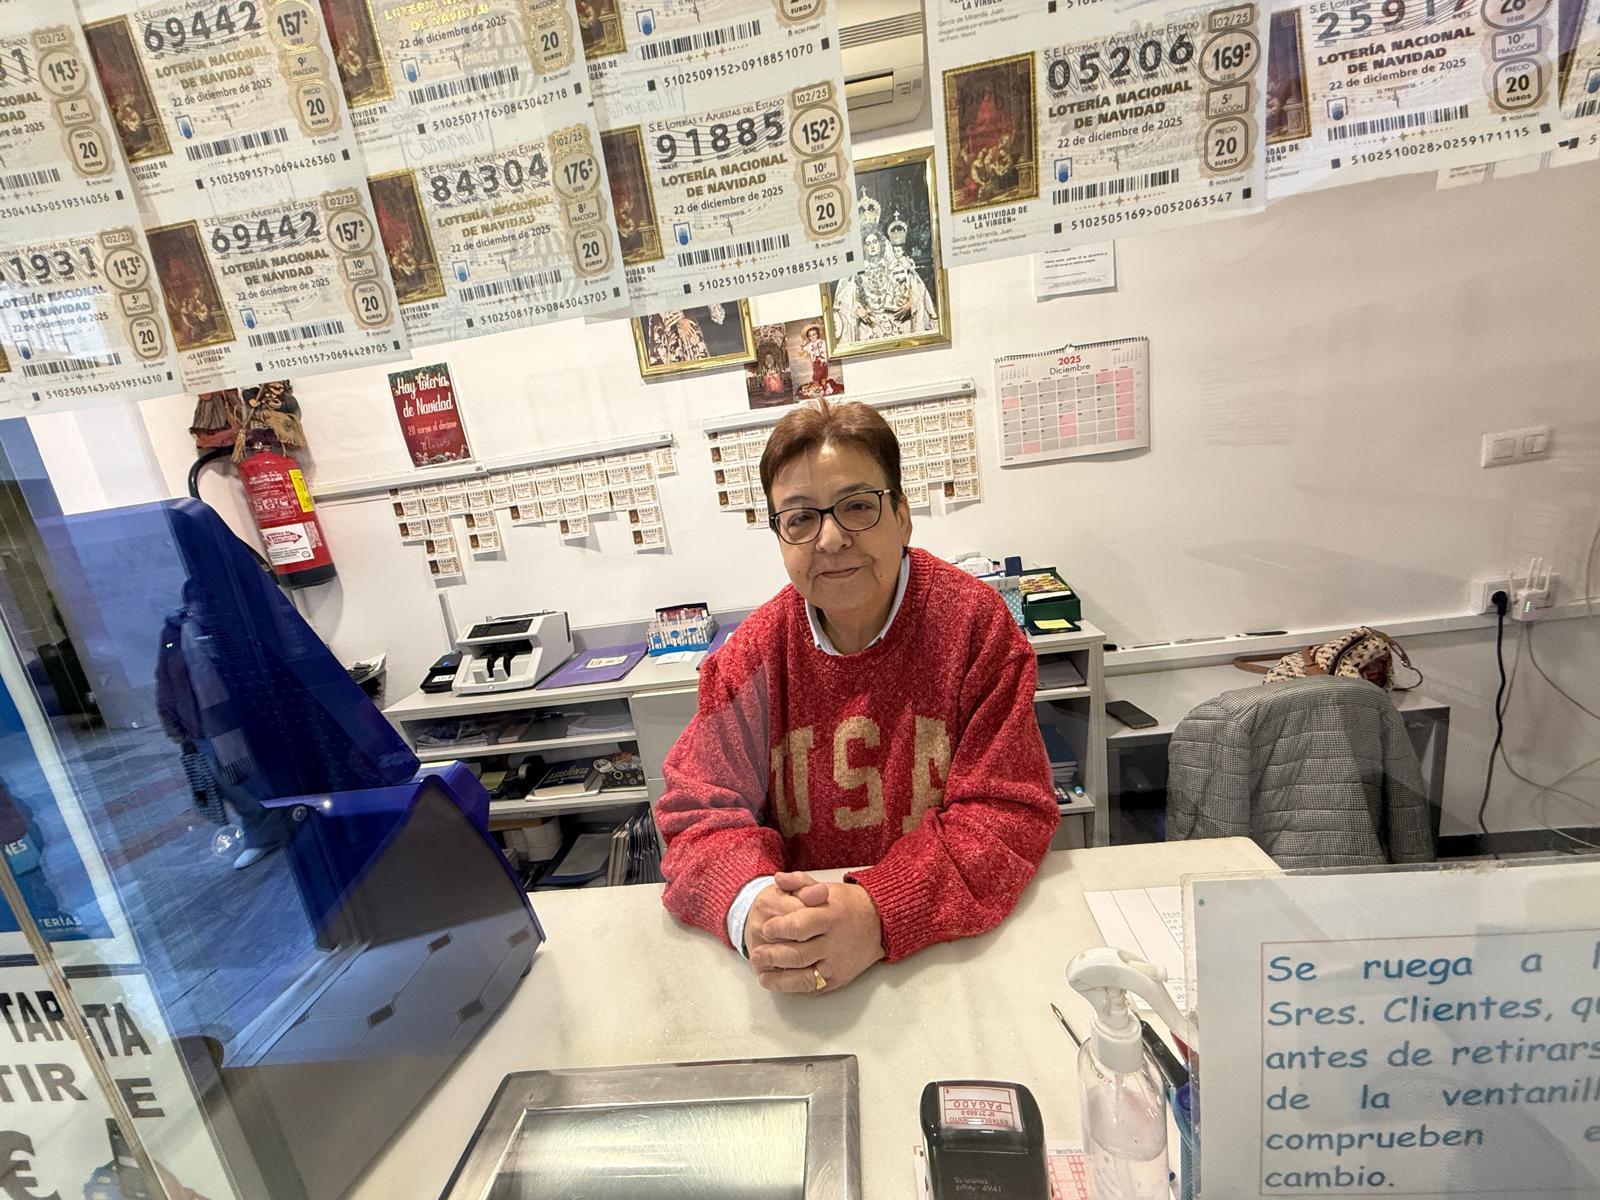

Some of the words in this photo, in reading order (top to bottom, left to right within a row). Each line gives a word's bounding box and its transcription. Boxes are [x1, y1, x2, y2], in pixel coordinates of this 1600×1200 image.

[791, 3, 812, 14] EUROS
[144, 1, 260, 51] 69442
[1213, 14, 1248, 28] 102/25
[399, 39, 410, 49] 22
[413, 36, 424, 47] de
[426, 27, 469, 44] diciembre
[472, 23, 484, 33] de
[485, 15, 507, 29] 2025
[541, 31, 559, 52] 20
[1318, 43, 1387, 67] LOTERÍA
[1391, 26, 1475, 52] NACIONAL
[1497, 42, 1536, 55] FRACCIÓN
[155, 57, 207, 79] LOTERÍA
[208, 46, 272, 67] NACIONAL
[1050, 34, 1194, 91] 05206
[1347, 60, 1369, 74] DE
[1373, 47, 1447, 69] NAVIDAD
[1505, 63, 1529, 73] PRECIO
[180, 78, 198, 89] DE
[200, 66, 255, 85] NAVIDAD
[1329, 80, 1342, 91] 22
[1346, 75, 1360, 88] de
[1363, 68, 1418, 85] diciembre
[1421, 64, 1436, 76] de
[1439, 58, 1467, 71] 2025
[1506, 74, 1530, 93] 20
[796, 89, 828, 104] 102/25
[1048, 95, 1111, 119] LOTERÍA
[1115, 80, 1192, 105] NACIONAL
[1506, 93, 1532, 102] EUROS
[307, 98, 325, 117] 20
[706, 109, 741, 123] APUESTAS
[742, 106, 755, 115] DEL
[755, 98, 785, 111] ESTADO
[1074, 115, 1095, 130] DE
[1099, 101, 1166, 126] NAVIDAD
[1211, 103, 1243, 115] FRACCIÓN
[556, 133, 583, 146] 102/25
[656, 110, 784, 164] 91885
[1058, 137, 1069, 149] 22
[1073, 132, 1086, 145] de
[1088, 125, 1139, 144] diciembre
[1141, 121, 1154, 133] de
[1157, 117, 1183, 130] 2025
[1214, 125, 1237, 135] PRECIO
[810, 144, 825, 152] SERIE
[1215, 137, 1237, 157] 20
[661, 167, 717, 187] LOTERÍA
[720, 153, 788, 174] NACIONAL
[1214, 157, 1238, 167] EUROS
[430, 152, 549, 202] 84304
[686, 186, 703, 198] DE
[707, 174, 767, 194] NAVIDAD
[807, 172, 836, 184] FRACCIÓN
[673, 206, 685, 215] 22
[687, 202, 699, 213] de
[700, 195, 745, 211] diciembre
[748, 191, 760, 202] de
[762, 186, 784, 198] 2025
[814, 191, 834, 200] PRECIO
[438, 209, 489, 228] LOTERÍA
[492, 195, 553, 215] NACIONAL
[816, 203, 836, 222] 20
[977, 208, 1015, 222] NATIVIDAD
[1018, 206, 1028, 214] DE
[211, 210, 321, 253] 69442
[462, 227, 478, 238] DE
[481, 214, 536, 235] NAVIDAD
[818, 221, 838, 230] EUROS
[974, 221, 985, 230] LA
[451, 244, 461, 253] 22
[463, 241, 474, 251] de
[475, 233, 516, 248] diciembre
[518, 230, 529, 241] de
[531, 225, 551, 237] 2025
[582, 241, 600, 259] 20
[0, 246, 96, 281] 1931
[221, 257, 269, 276] LOTERÍA
[271, 249, 330, 267] NACIONAL
[586, 259, 603, 268] EUROS
[245, 275, 260, 286] DE
[262, 266, 314, 283] NAVIDAD
[48, 284, 107, 303] NACIONAL
[236, 292, 246, 301] 22
[248, 289, 258, 299] de
[260, 283, 298, 297] diciembre
[299, 281, 310, 290] de
[311, 278, 330, 288] 2025
[20, 310, 36, 320] DE
[39, 302, 91, 318] NAVIDAD
[361, 295, 379, 313] 20
[365, 312, 383, 321] EUROS
[139, 330, 155, 344] 20
[1049, 364, 1091, 376] Diciembre
[1058, 355, 1082, 366] 2025
[397, 378, 416, 400] Hay
[403, 401, 415, 418] de
[417, 393, 453, 415] Navidad
[38, 915, 82, 928] ERÍAS
[1267, 956, 1317, 983] Se
[1362, 955, 1473, 985] ruega
[1520, 952, 1542, 974] a
[1267, 1001, 1365, 1027] Sres.
[1383, 995, 1552, 1024] Clientes,
[1265, 1045, 1368, 1070] antes
[1387, 1040, 1433, 1067] de
[954, 1101, 1001, 1110] PAGADO
[1266, 1086, 1311, 1111] de
[1362, 1084, 1390, 1110] la
[1265, 1124, 1484, 1156] comprueben
[1264, 1165, 1394, 1189] cambio.
